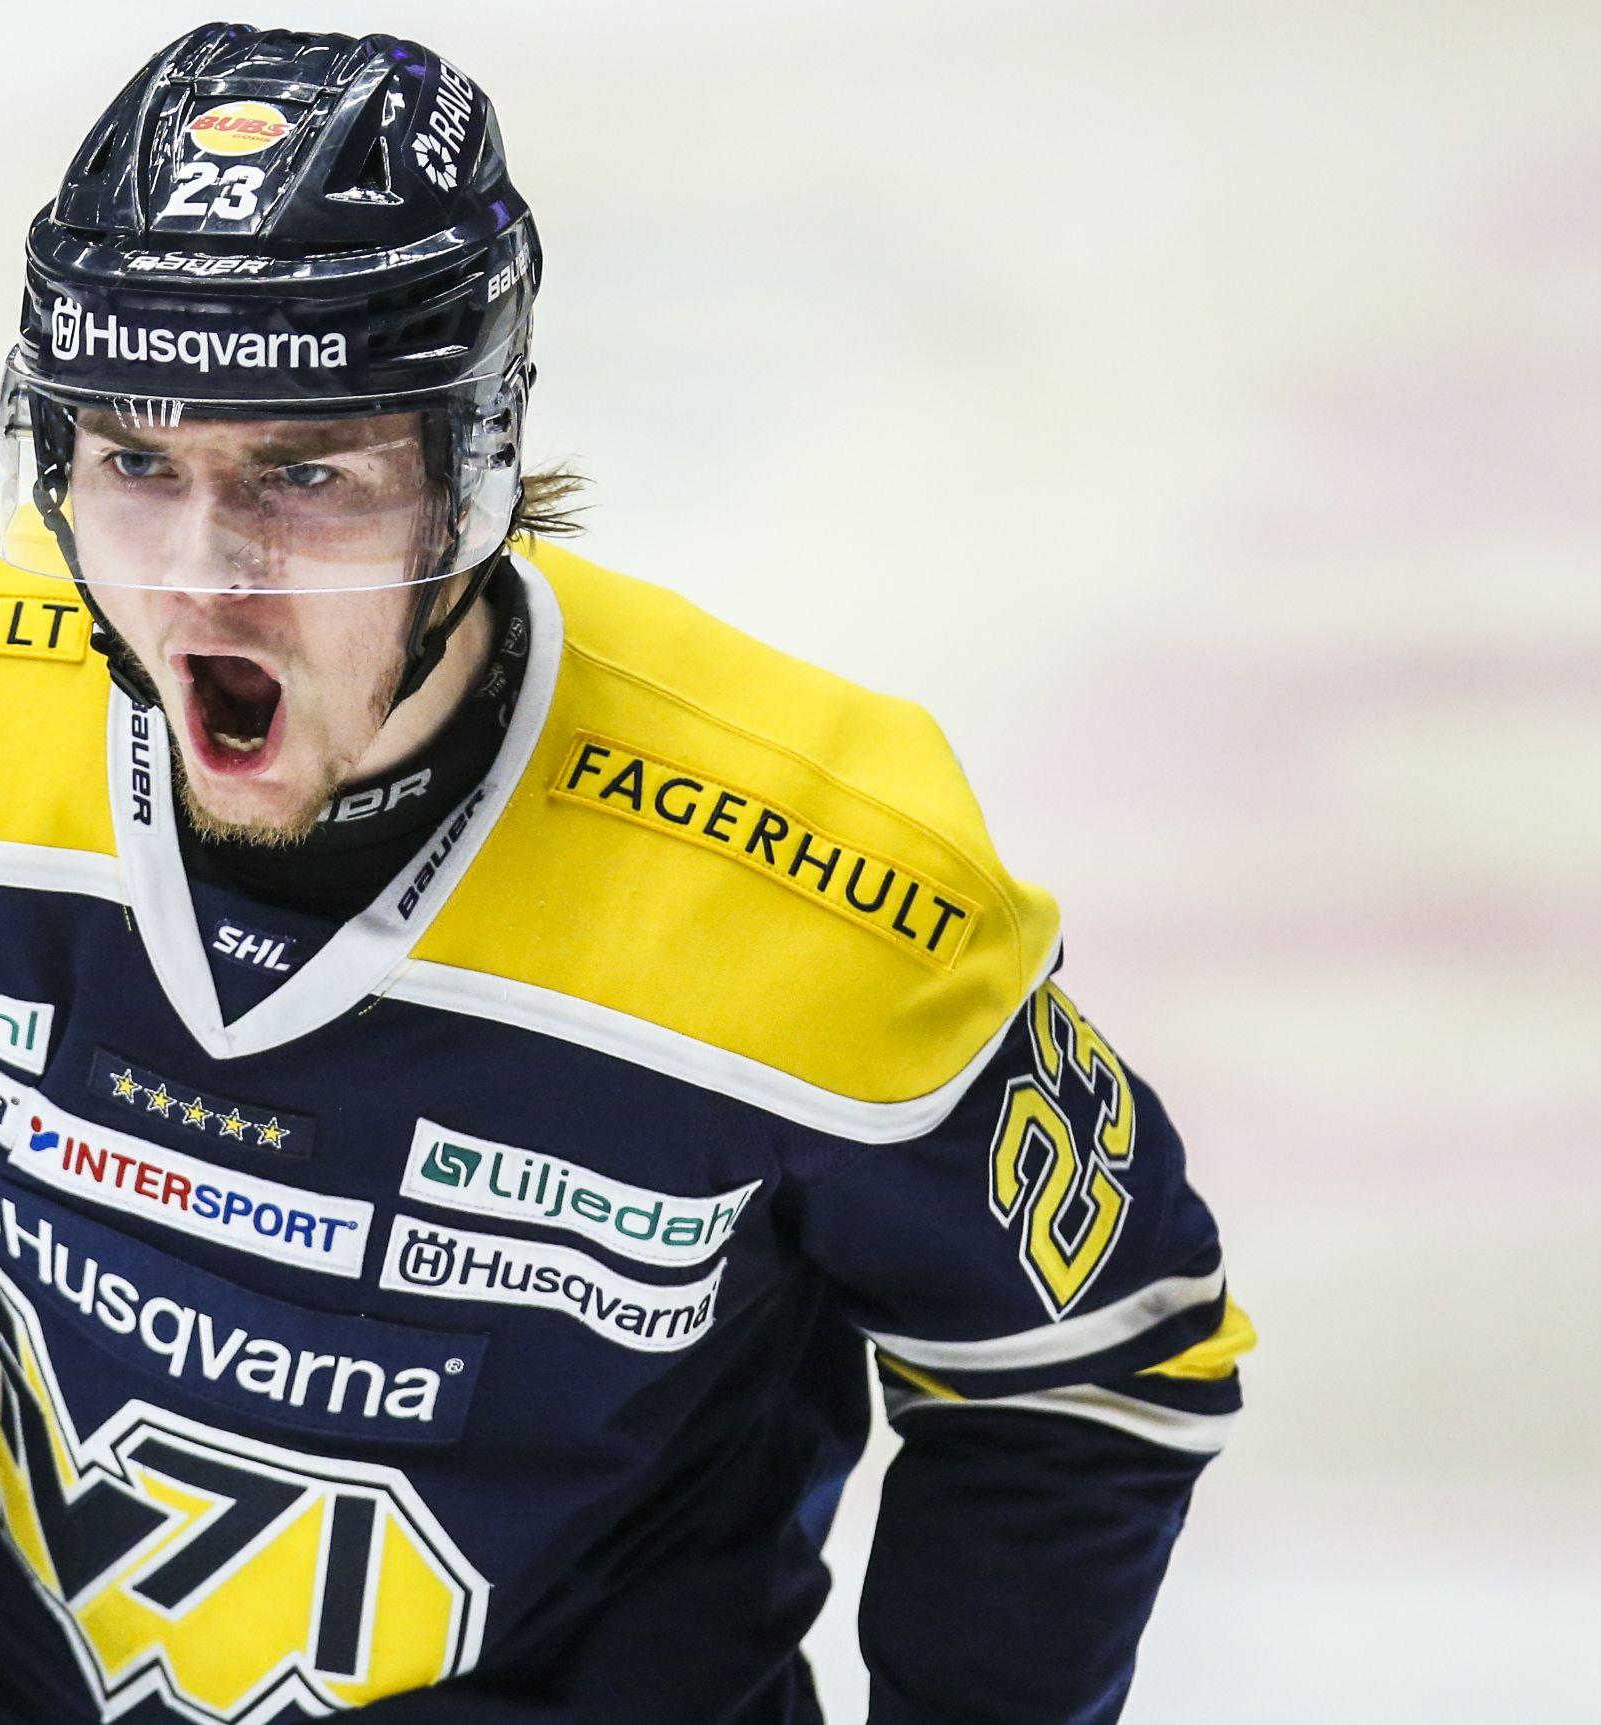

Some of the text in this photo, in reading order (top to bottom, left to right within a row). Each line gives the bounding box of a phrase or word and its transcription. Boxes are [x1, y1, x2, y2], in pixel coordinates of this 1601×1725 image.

[189, 115, 290, 137] BUBS
[429, 58, 474, 154] RAVE
[164, 161, 266, 220] 23
[85, 313, 348, 374] Husqvarna
[568, 744, 966, 952] FAGERHULT
[213, 925, 290, 972] SHL
[62, 1138, 349, 1254] INTERSPORT
[990, 978, 1136, 1322] 23
[0, 1196, 440, 1421] Husqvarna
